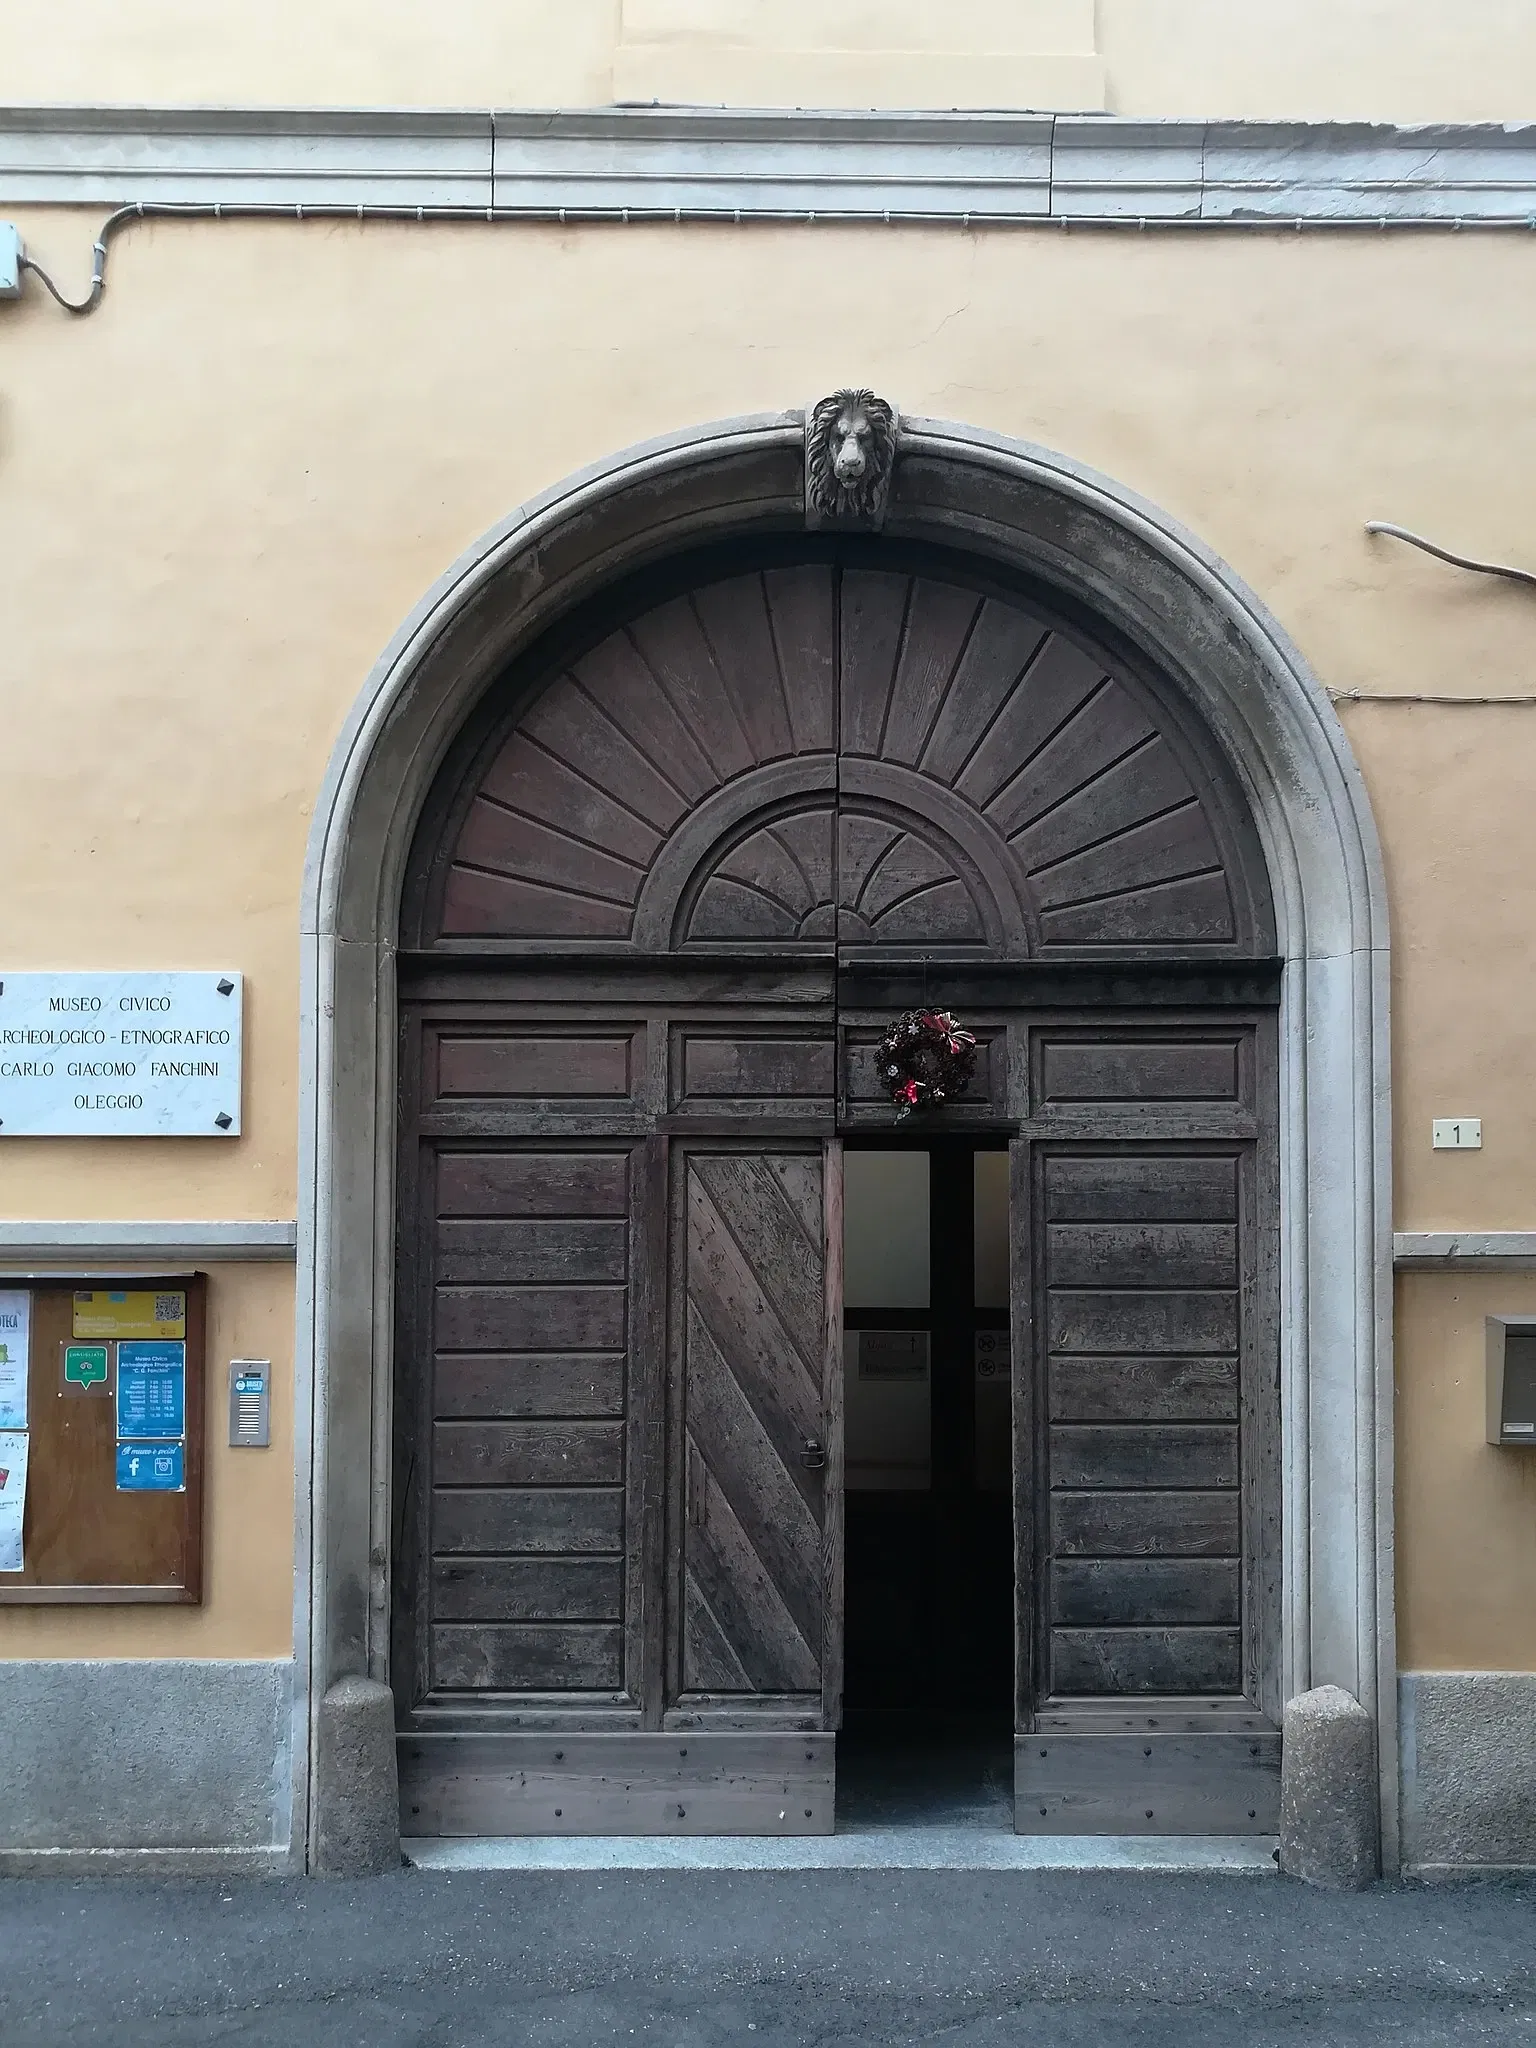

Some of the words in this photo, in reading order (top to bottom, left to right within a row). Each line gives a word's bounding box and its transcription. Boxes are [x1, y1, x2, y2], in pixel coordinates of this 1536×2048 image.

[49, 997, 101, 1011] MUSEO
[119, 997, 171, 1011] CIVICO
[0, 1029, 105, 1044] RCHEOLOGICO
[121, 1029, 230, 1044] ETNOGRAFICO
[1, 1062, 54, 1077] CARLO
[67, 1062, 136, 1077] GIACOMO
[151, 1062, 219, 1077] FANCHINI
[74, 1094, 143, 1109] OLEGGIO
[1453, 1125, 1461, 1144] 1
[0, 1315, 18, 1328] TECA
